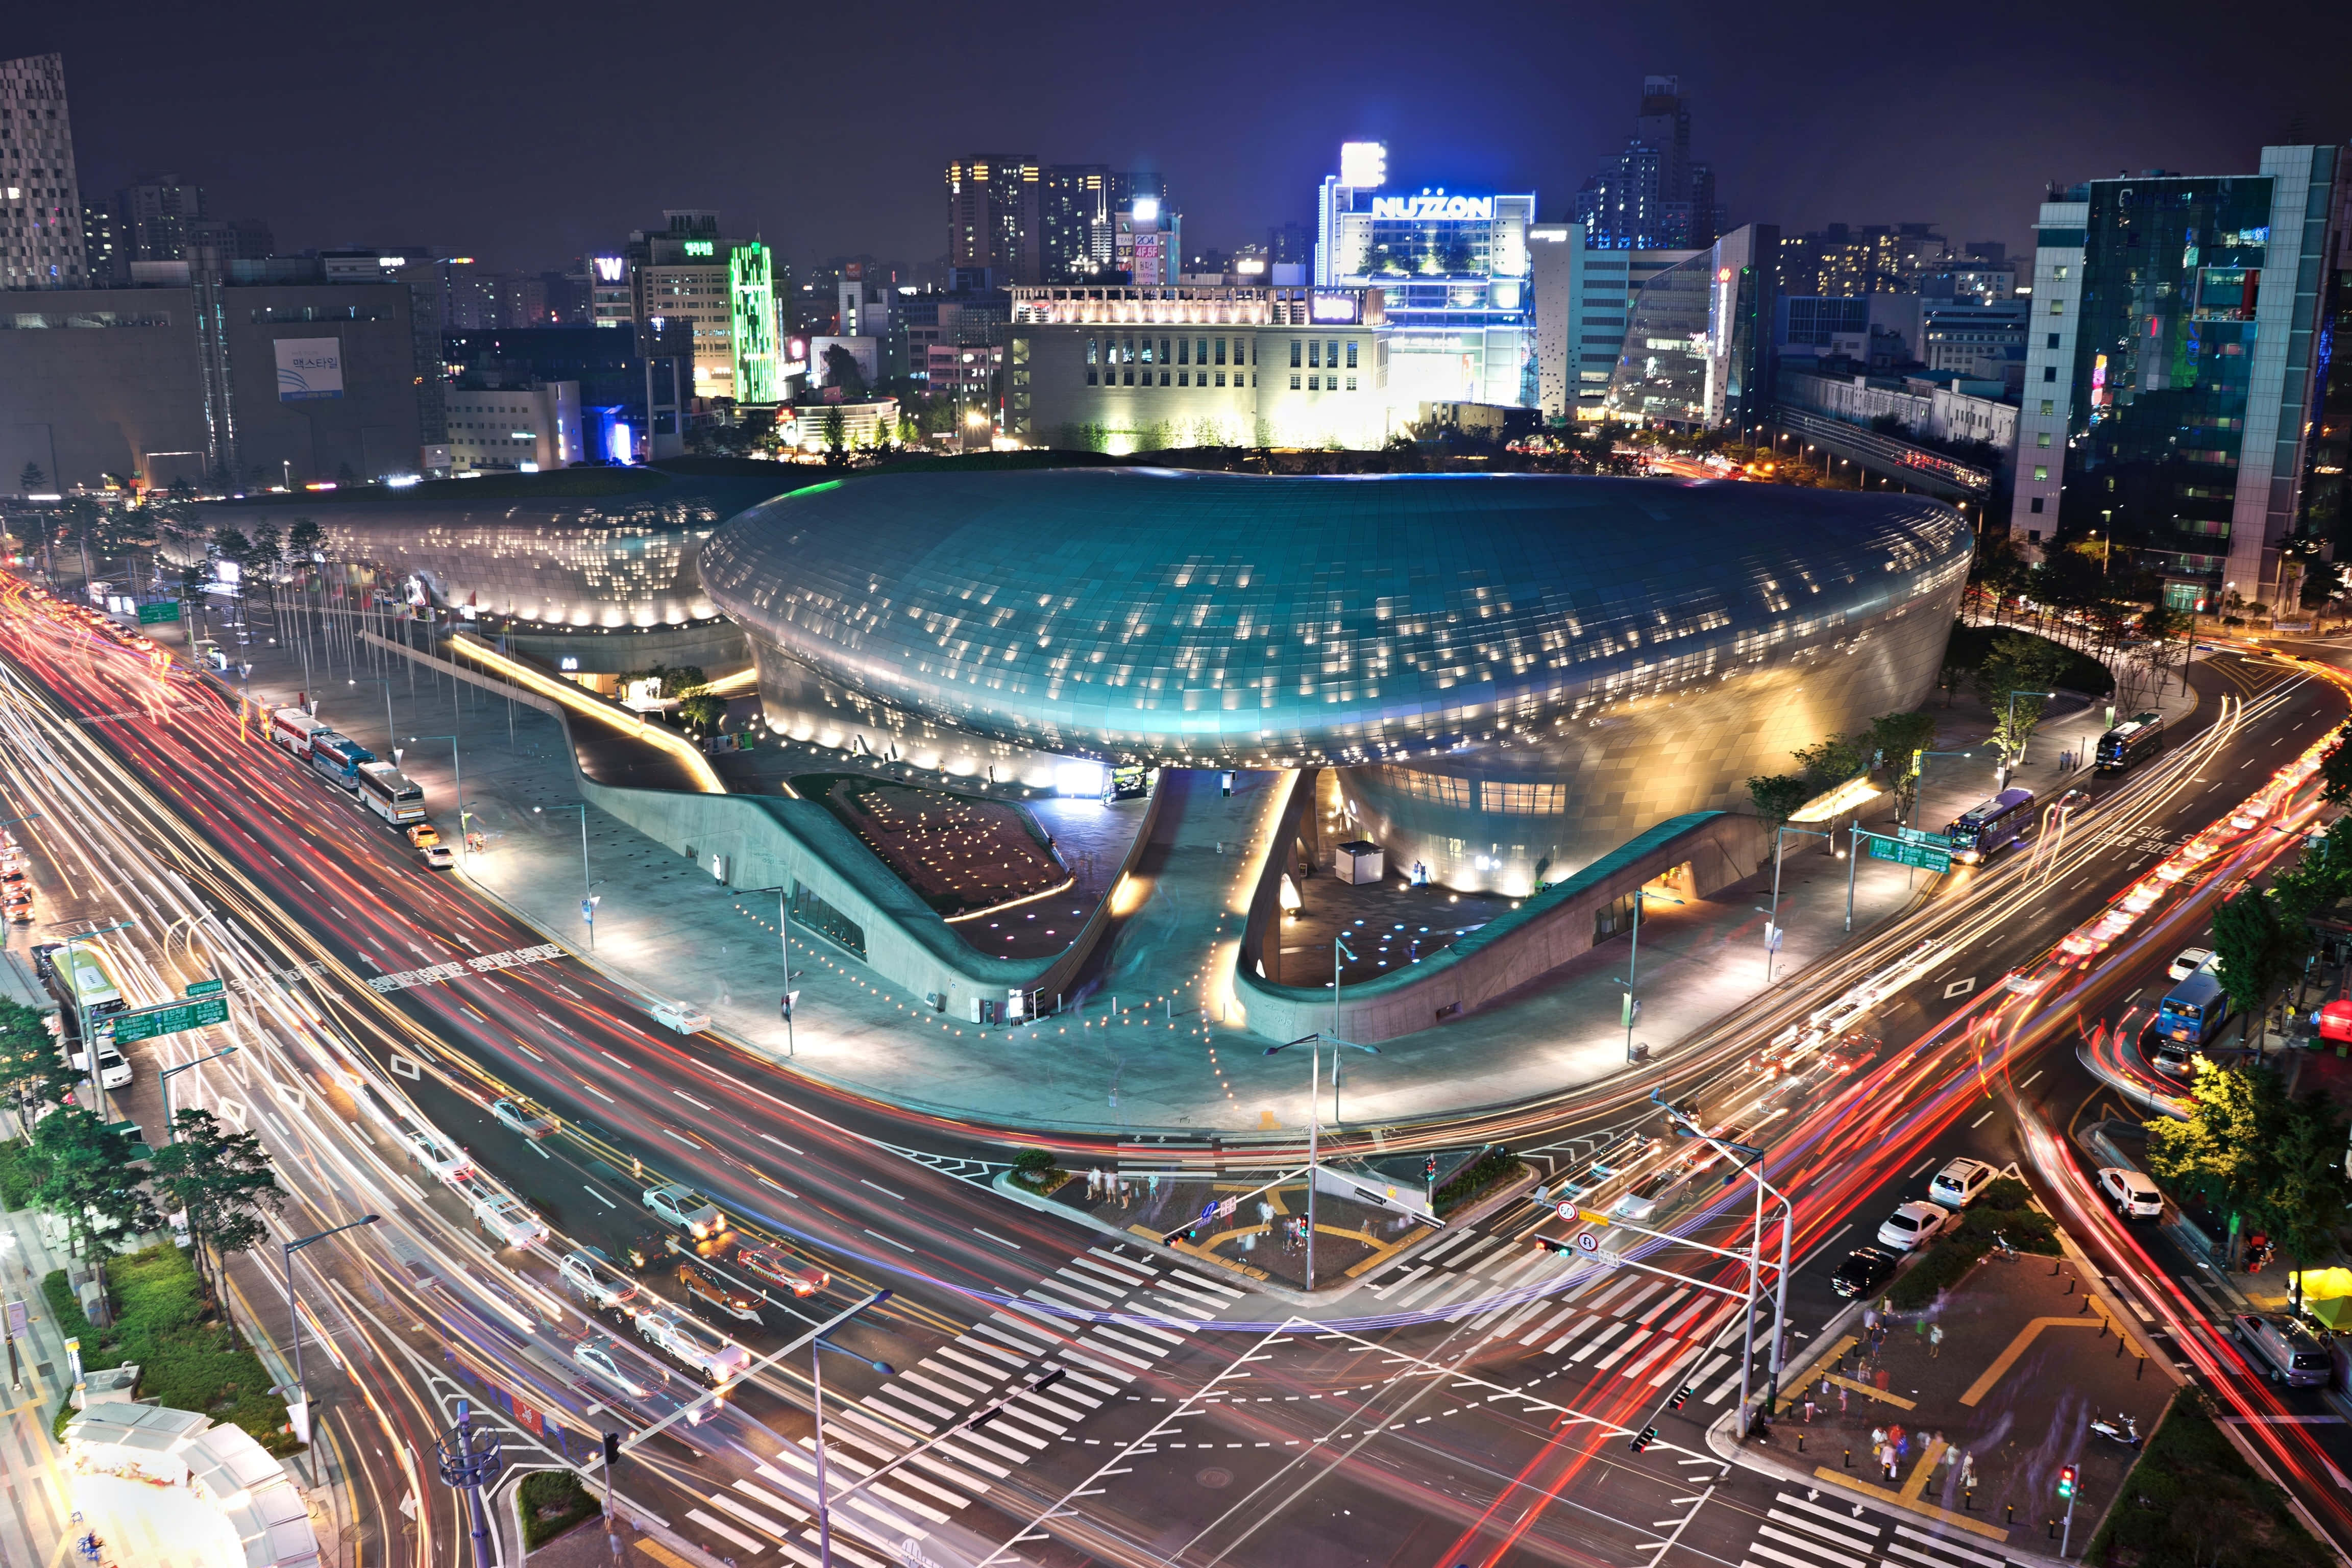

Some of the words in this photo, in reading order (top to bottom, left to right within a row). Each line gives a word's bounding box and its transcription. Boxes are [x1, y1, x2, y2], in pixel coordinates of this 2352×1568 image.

[1137, 236, 1154, 245] 204
[1118, 247, 1132, 256] 3F
[1136, 247, 1158, 257] 4F,5F
[1140, 261, 1154, 270] 원피스
[293, 357, 338, 370] 맥스타일
[1560, 1206, 1573, 1216] 60
